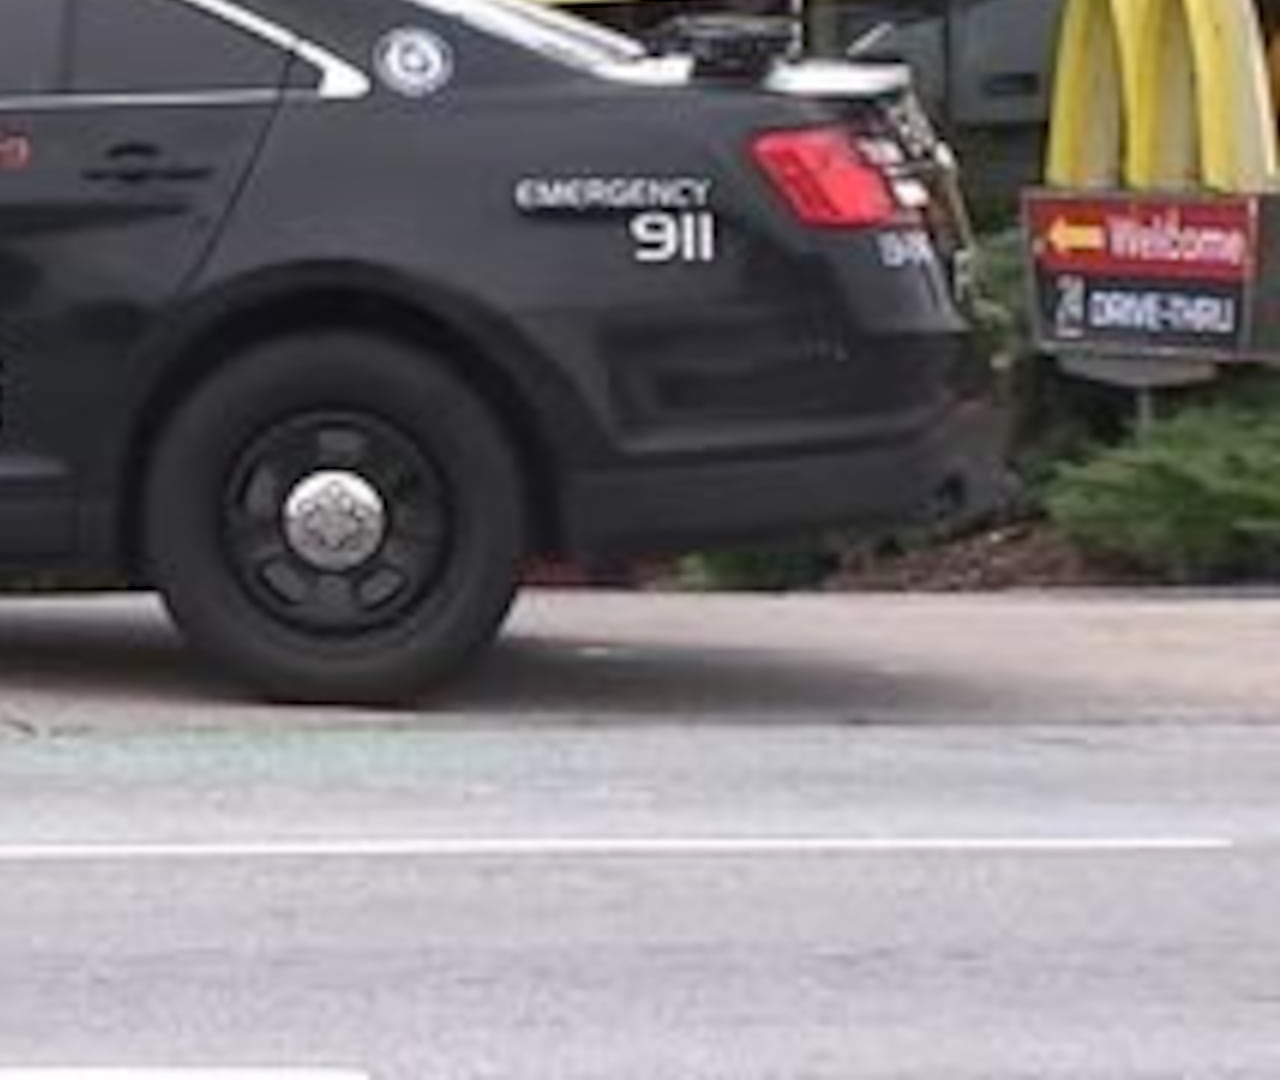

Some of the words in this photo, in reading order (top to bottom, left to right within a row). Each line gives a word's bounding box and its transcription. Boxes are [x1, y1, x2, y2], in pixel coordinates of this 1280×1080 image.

[514, 176, 713, 210] EMERGENCY
[628, 212, 715, 262] 911
[1104, 205, 1246, 265] Welcome
[1088, 288, 1236, 336] DRIVE-THRU
